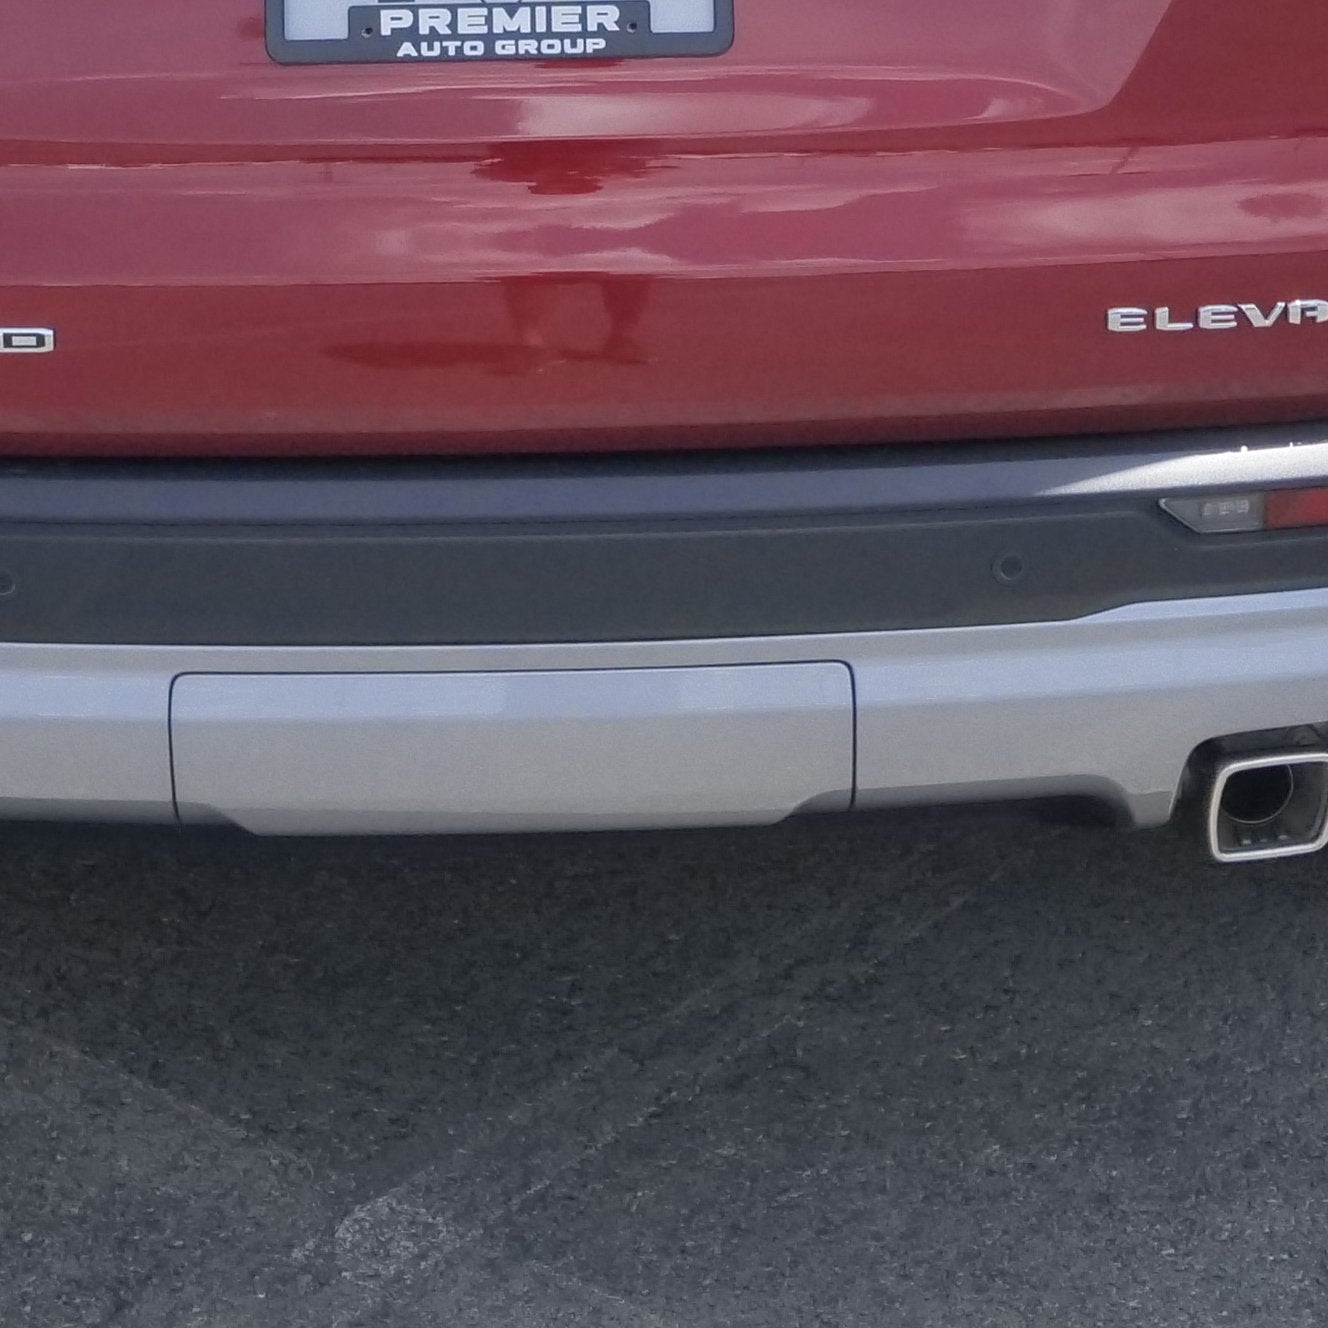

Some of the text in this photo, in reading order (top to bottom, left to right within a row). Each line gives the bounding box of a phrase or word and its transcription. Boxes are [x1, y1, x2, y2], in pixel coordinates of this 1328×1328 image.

[379, 5, 621, 37] PREMIER
[396, 38, 607, 58] AUTO GROUP
